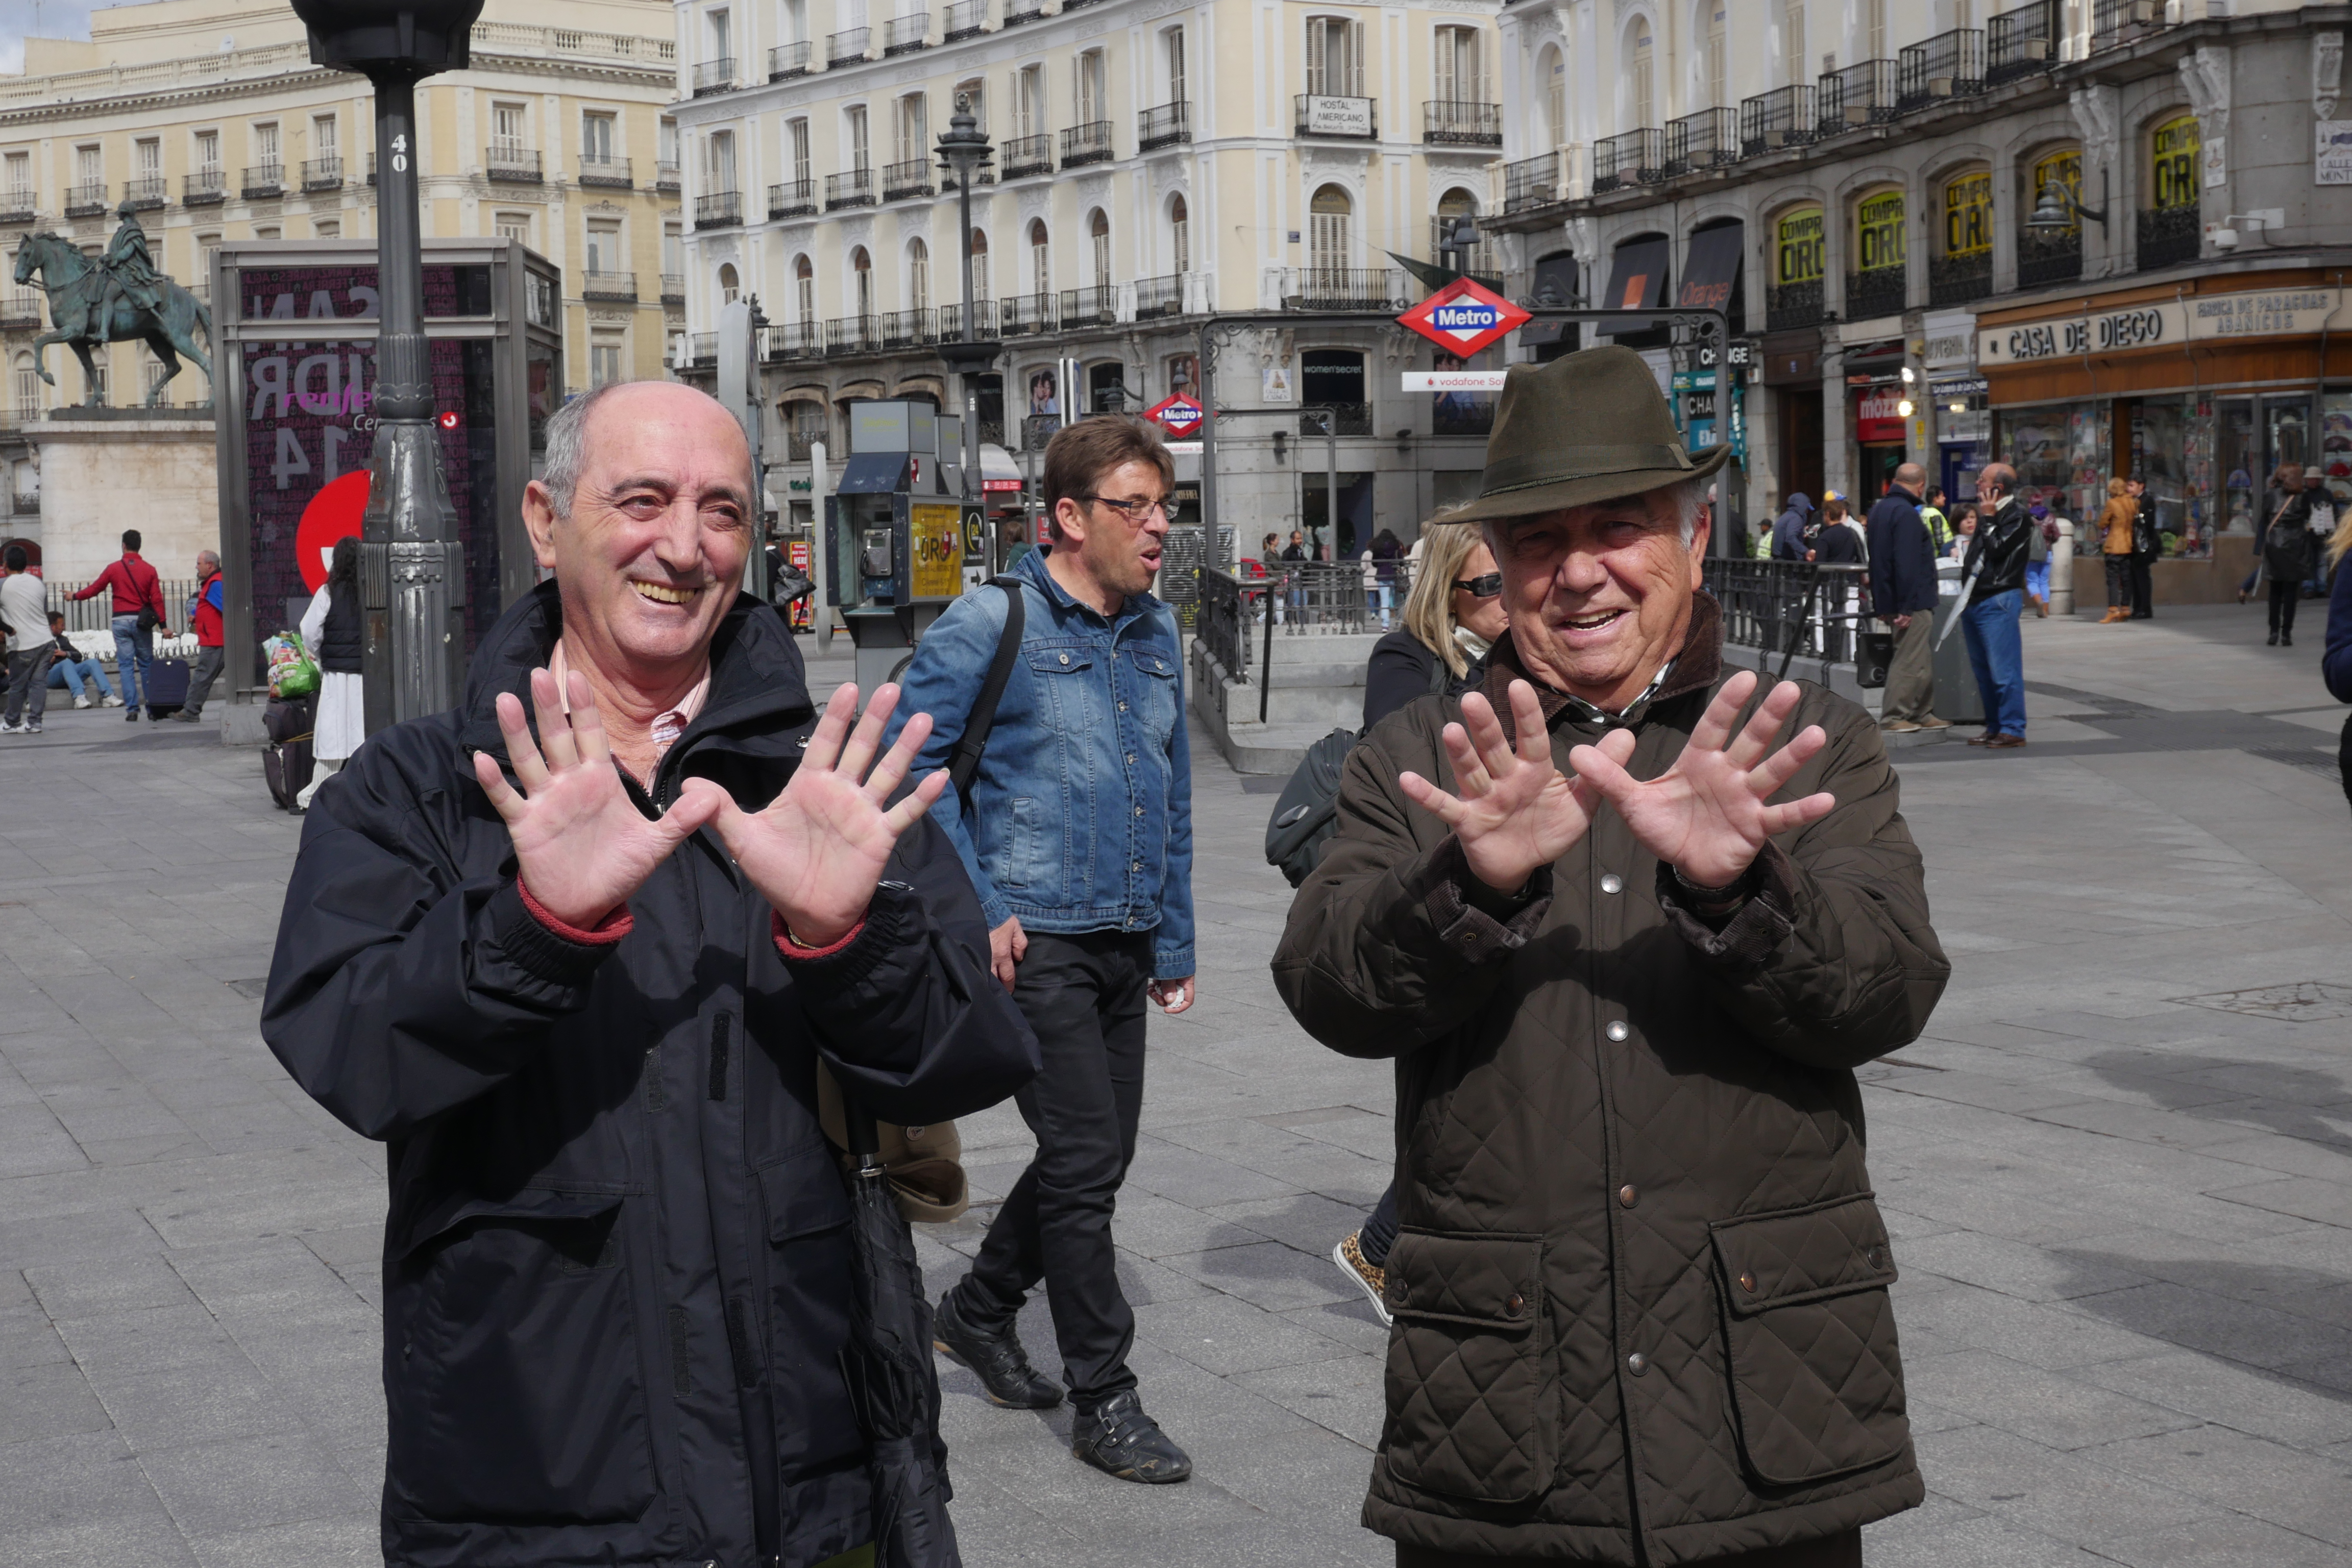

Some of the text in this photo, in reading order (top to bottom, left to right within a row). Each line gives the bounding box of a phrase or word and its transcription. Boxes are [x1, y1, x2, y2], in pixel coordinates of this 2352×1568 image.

[1320, 100, 1351, 110] HOSTAL
[1317, 112, 1364, 122] AMERICANO
[2156, 122, 2199, 155] COMPR
[391, 134, 407, 172] 40
[2036, 156, 2082, 189] COMPR
[2321, 159, 2352, 168] CALLE
[1947, 178, 1992, 208] COMPR
[1861, 198, 1904, 225] COMPR
[1780, 215, 1823, 241] COMPR
[1681, 281, 1729, 309] Orange
[2197, 292, 2329, 318] FABRICA DE PARAGUAS
[1438, 309, 1492, 326] Metro
[2217, 312, 2294, 333] ABANICOS
[2008, 325, 2056, 358] CASA
[2065, 320, 2090, 353] DE
[2099, 308, 2163, 349] DIEGO
[1700, 347, 1749, 365] CHNGE
[1303, 364, 1362, 374] women'secret
[1439, 377, 1504, 385] vodafone Sol
[283, 382, 372, 417] renfe
[1689, 396, 1717, 414] CHA
[1164, 409, 1197, 420] Metro
[1177, 489, 1198, 500] RTEFIEL
[971, 524, 979, 536] 24
